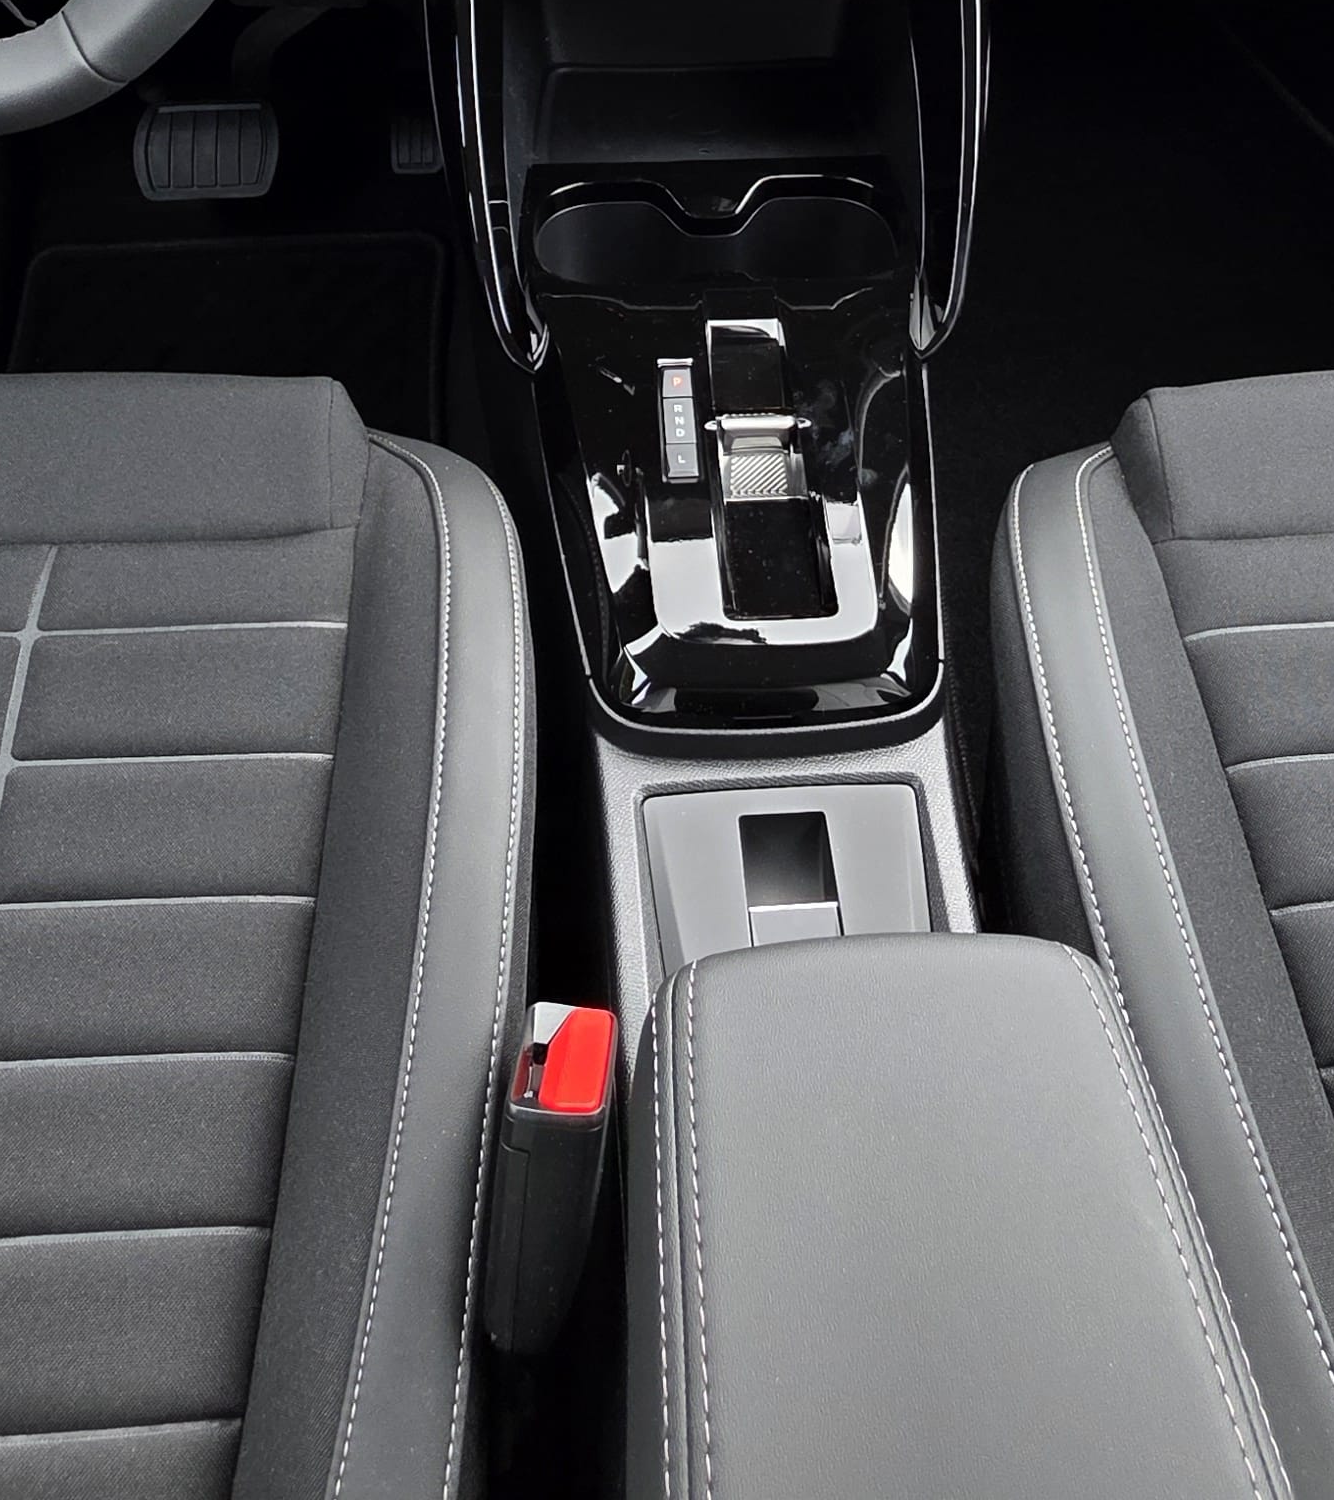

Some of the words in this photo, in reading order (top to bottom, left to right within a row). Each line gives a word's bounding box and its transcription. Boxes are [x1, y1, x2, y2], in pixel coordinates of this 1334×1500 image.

[673, 377, 682, 387] P
[674, 404, 683, 413] R
[675, 417, 684, 425] N
[676, 429, 685, 437] D
[678, 455, 686, 464] L
